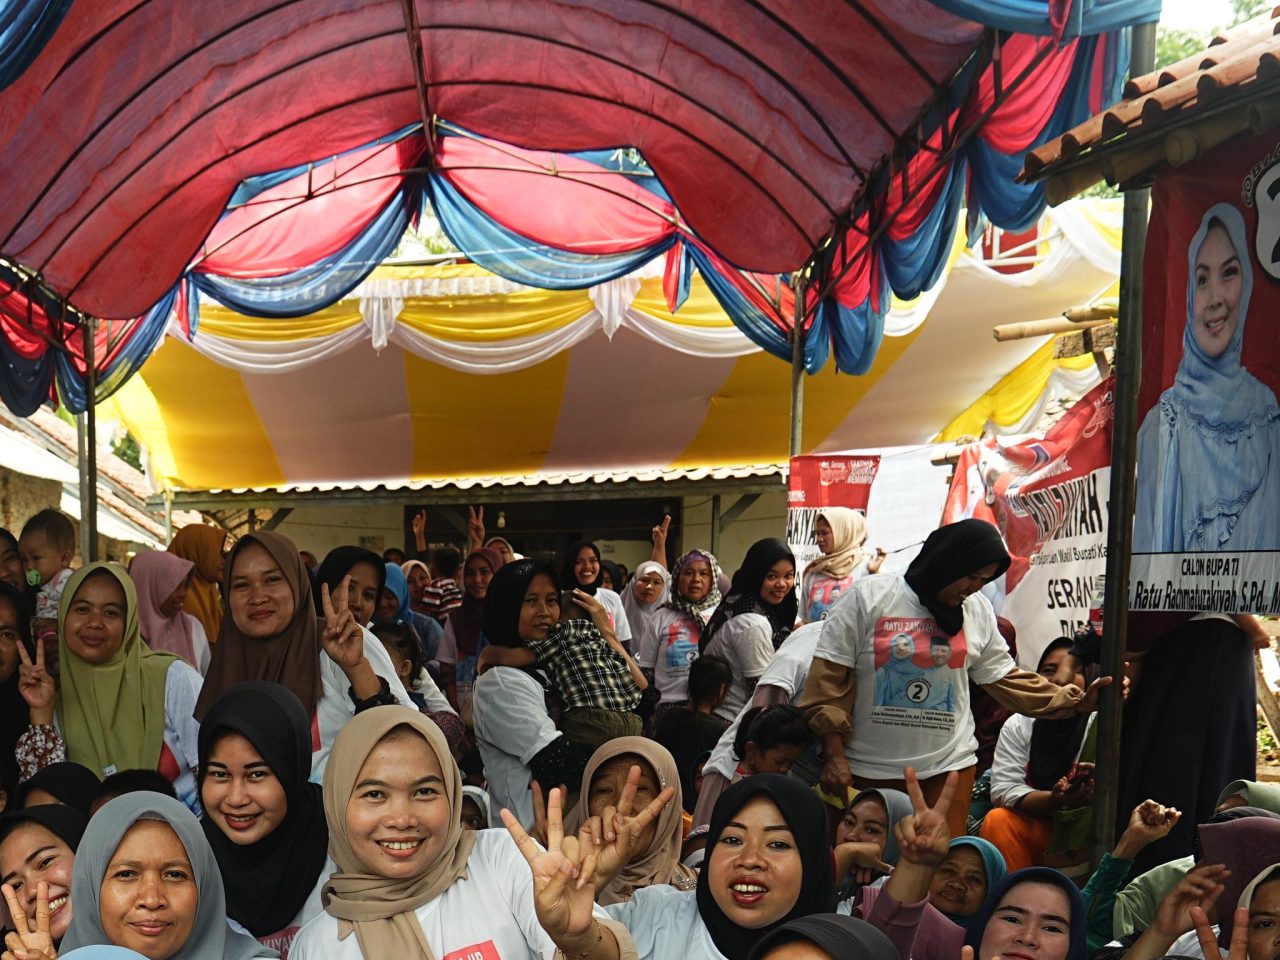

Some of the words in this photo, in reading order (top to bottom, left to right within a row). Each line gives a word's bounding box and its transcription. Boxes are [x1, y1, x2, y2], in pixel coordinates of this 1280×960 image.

[1181, 558, 1205, 576] CALON
[1206, 557, 1240, 576] BUPATI
[1134, 580, 1162, 610] Ratu
[883, 621, 904, 632] RATU
[911, 684, 924, 701] 2
